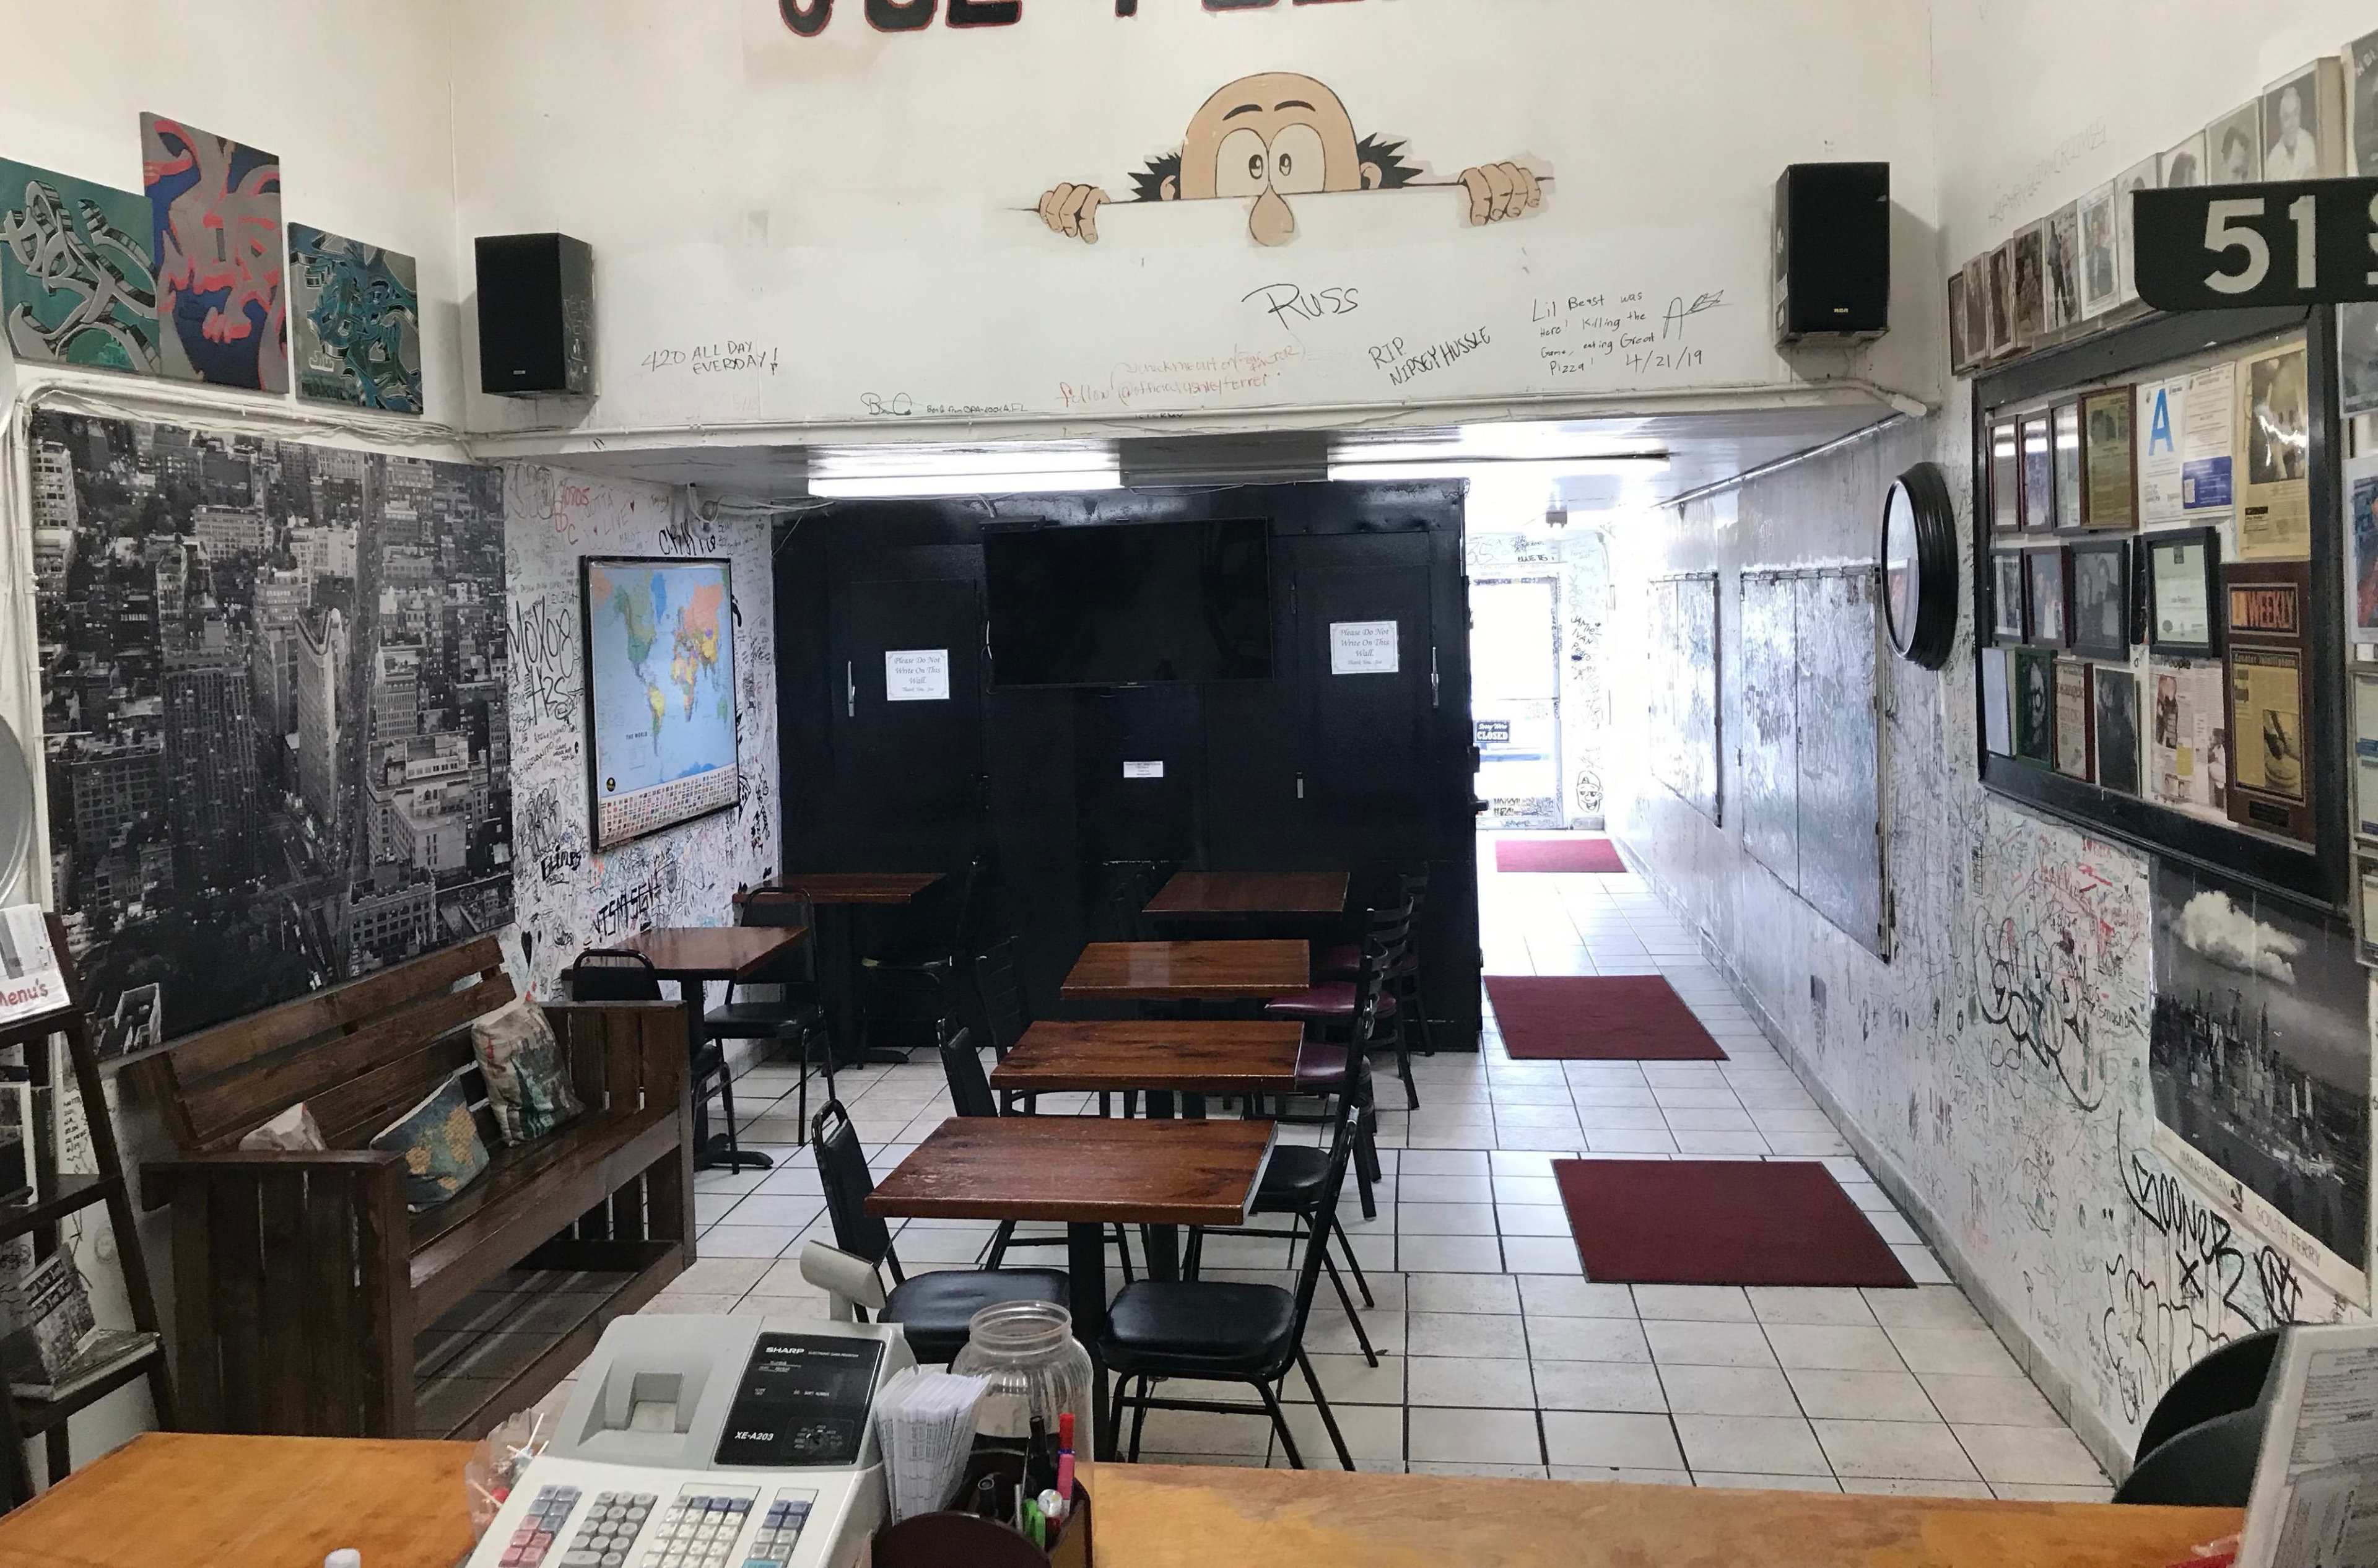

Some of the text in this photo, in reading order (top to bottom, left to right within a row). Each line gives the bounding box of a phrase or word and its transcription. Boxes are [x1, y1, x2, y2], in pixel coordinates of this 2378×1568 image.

[2203, 195, 2317, 294] 51
[1241, 284, 1359, 330] RUSS
[1532, 292, 1642, 322] Lil Beast was
[1582, 316, 1621, 332] Killing
[1626, 310, 1647, 321] the
[1583, 341, 1613, 355] eating
[1620, 332, 1655, 348] Great
[641, 340, 752, 372] 420 ALL DAY
[1389, 326, 1491, 386] NIPSEY HUSSLE
[1626, 346, 1702, 373] 4/21/19
[2148, 388, 2174, 456] A
[1341, 628, 1361, 636] Please
[1375, 627, 1389, 635] Not
[1341, 638, 1361, 647] Write
[1375, 638, 1390, 647] This
[894, 656, 914, 664] Please
[926, 665, 941, 674] This
[1476, 731, 1509, 740] CLOSED
[2256, 1204, 2322, 1267] SOUTH FERRY
[765, 1346, 805, 1354] SHARP
[734, 1431, 774, 1442] XE-A203
